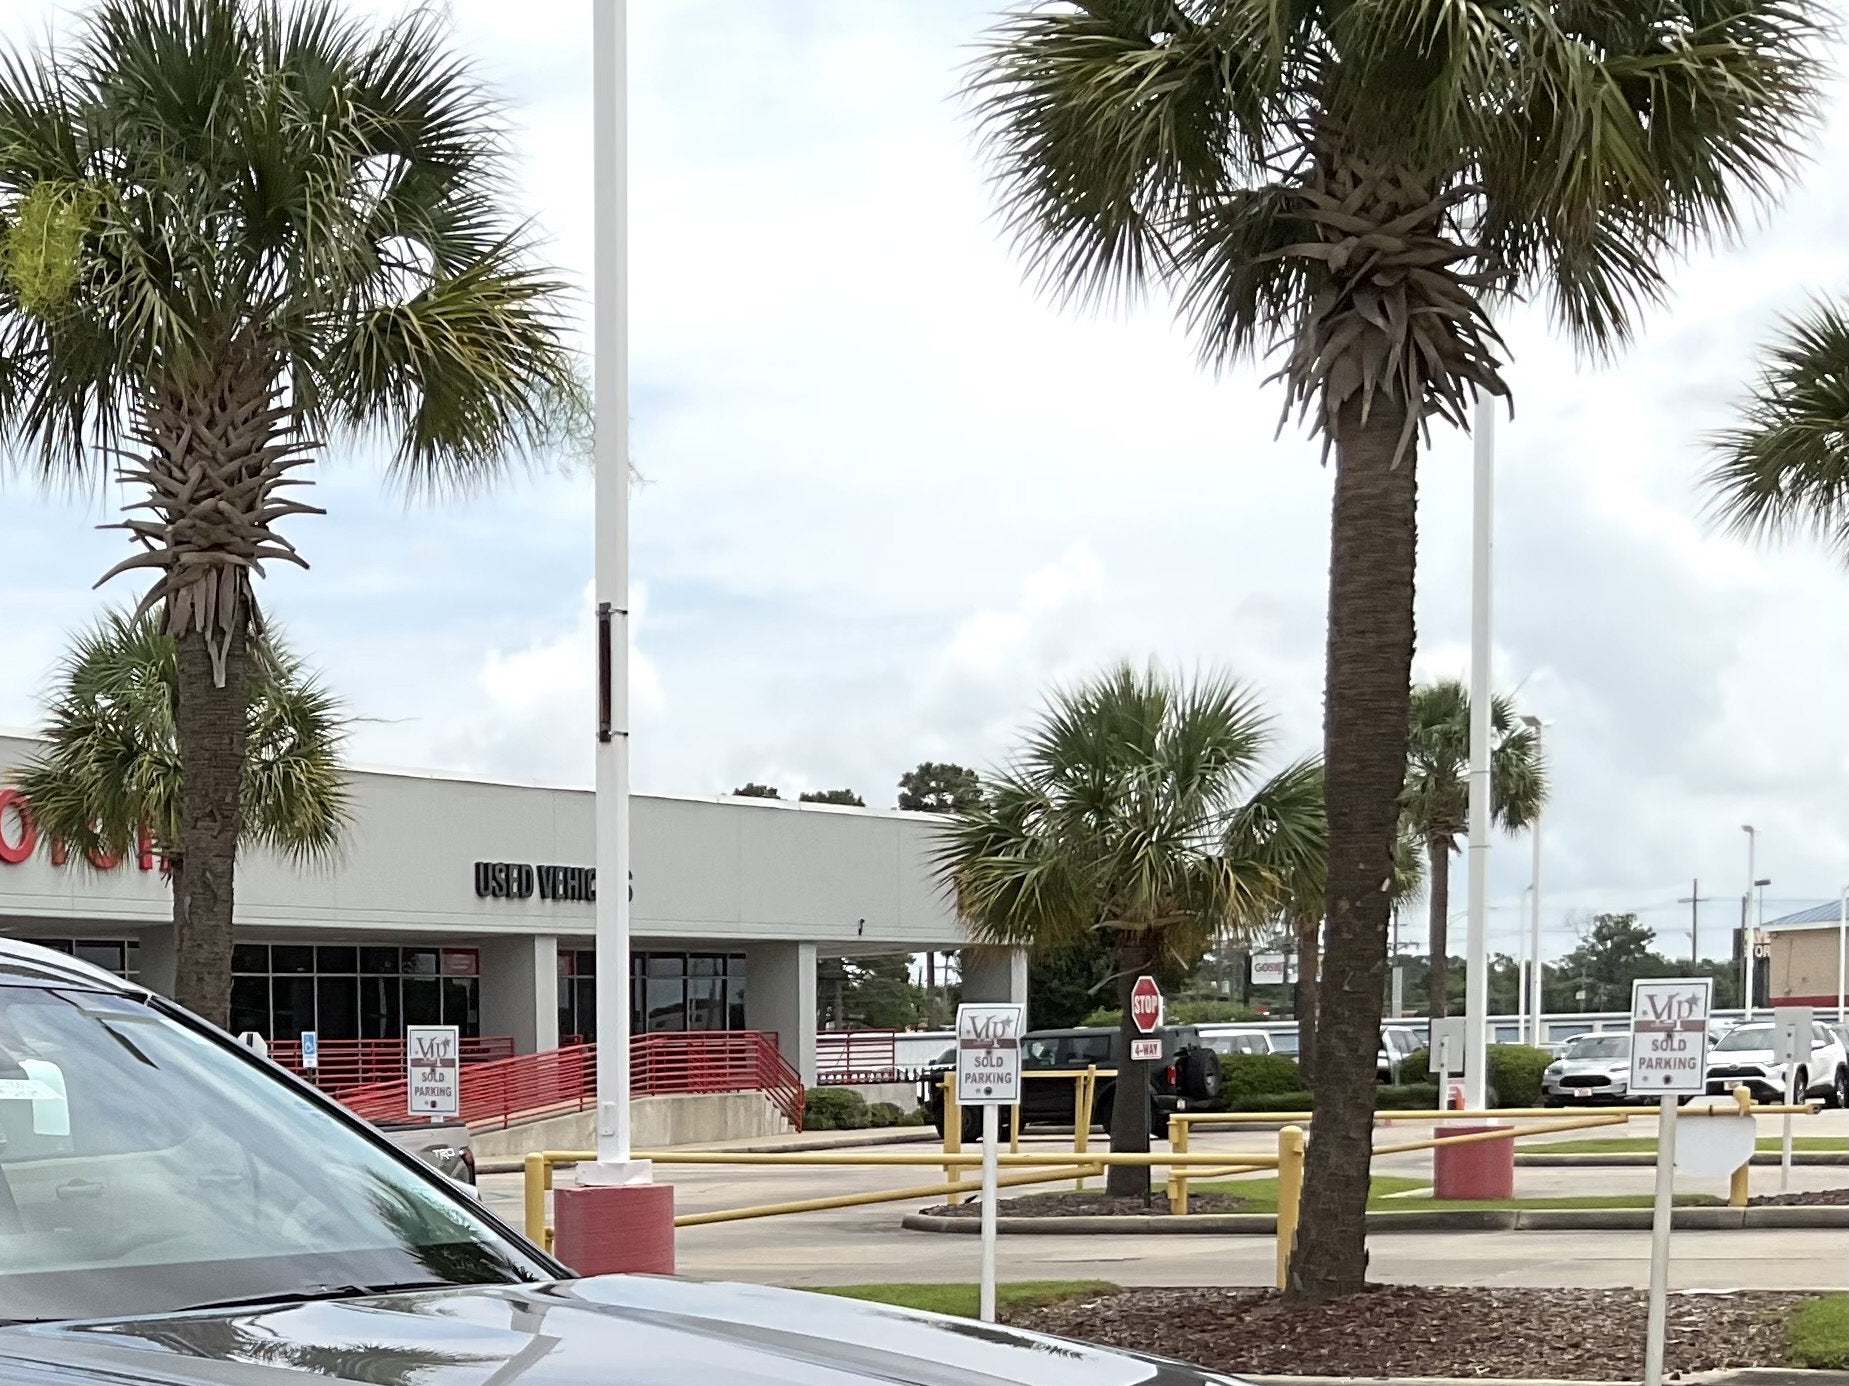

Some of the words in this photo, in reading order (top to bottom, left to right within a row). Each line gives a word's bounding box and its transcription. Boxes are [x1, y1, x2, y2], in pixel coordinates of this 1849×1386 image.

[475, 861, 534, 898] USED
[536, 864, 634, 902] VEHIC
[1134, 995, 1158, 1014] STOP
[1135, 1043, 1158, 1056] 4-WAY
[1651, 1039, 1687, 1052] SOLD
[974, 1056, 1004, 1068] SOLD
[1638, 1057, 1697, 1070] PARKING
[421, 1072, 445, 1083] SOLD
[964, 1072, 1012, 1084] PARKING
[414, 1086, 452, 1097] PARKING
[432, 1148, 456, 1160] TRD
